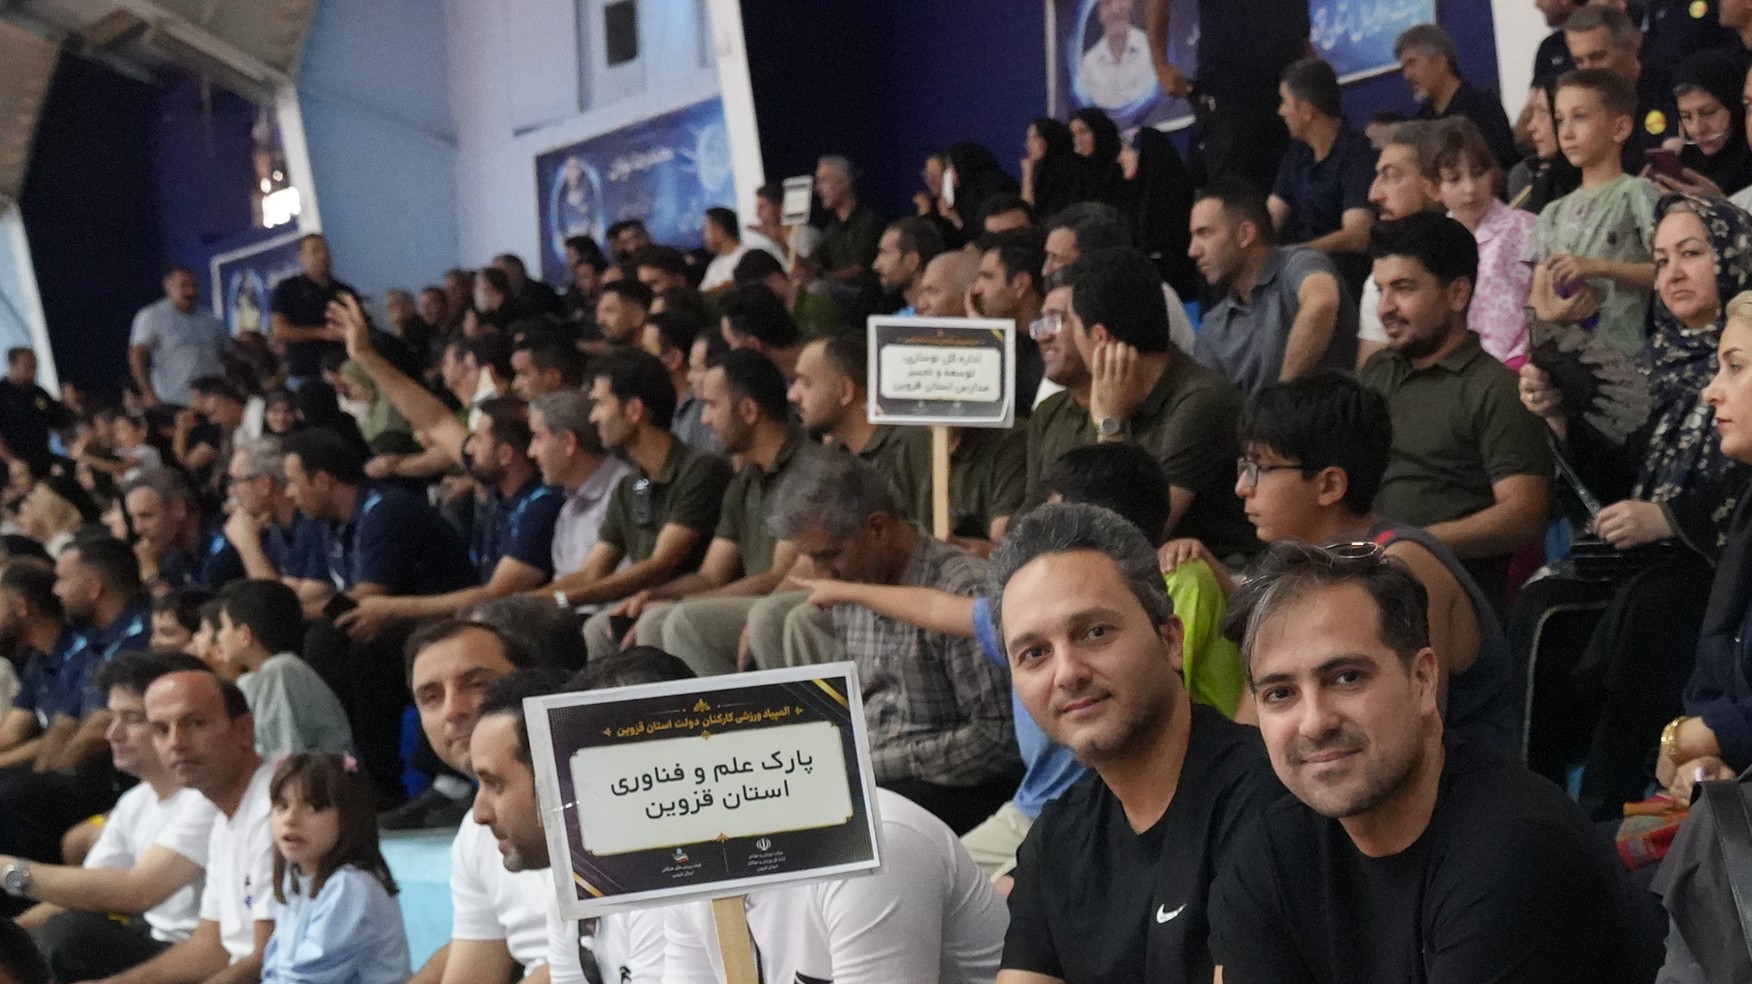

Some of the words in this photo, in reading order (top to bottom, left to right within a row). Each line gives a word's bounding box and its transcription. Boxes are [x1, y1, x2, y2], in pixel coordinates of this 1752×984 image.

[617, 721, 645, 737] قزوین
[646, 720, 672, 734] استان
[674, 717, 700, 730] دولت
[714, 757, 754, 779] علم
[762, 750, 813, 774] پارک
[611, 764, 685, 797] فناوری
[695, 768, 706, 784] و
[645, 789, 714, 820] قزوین
[723, 780, 790, 809] استان
